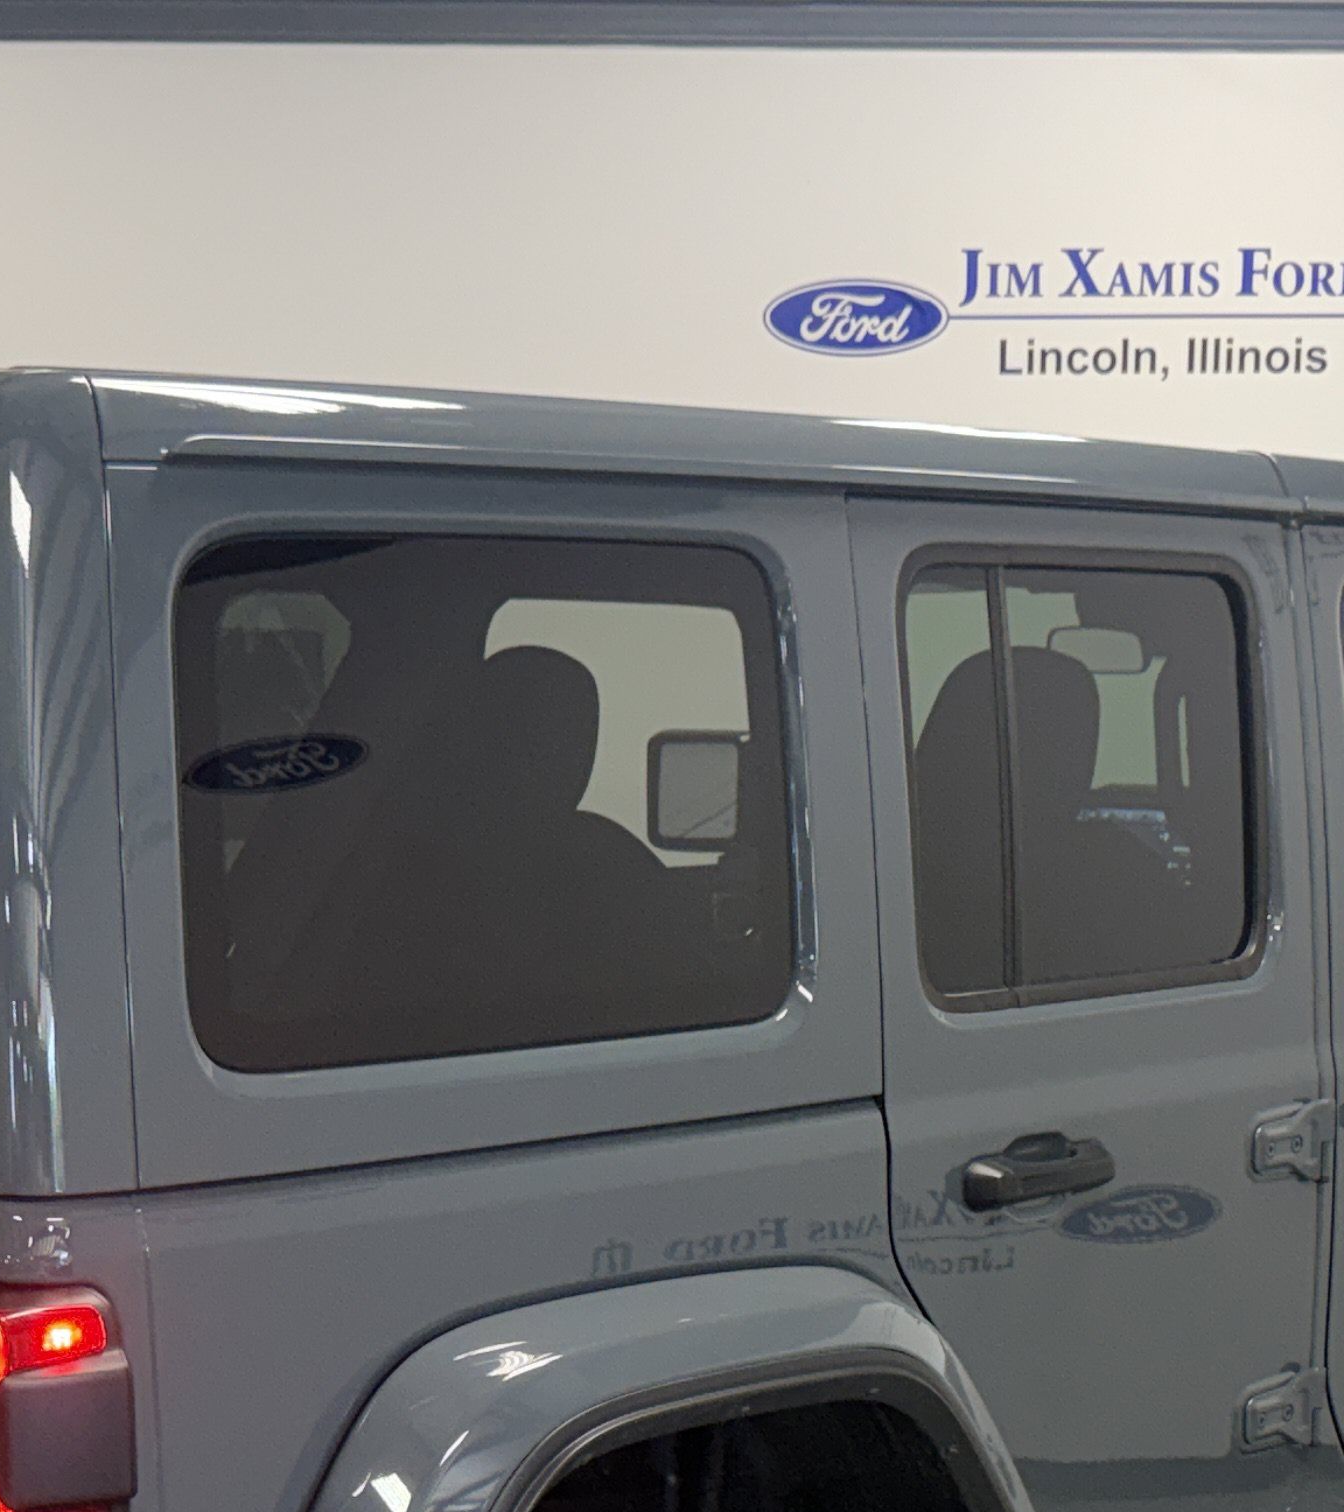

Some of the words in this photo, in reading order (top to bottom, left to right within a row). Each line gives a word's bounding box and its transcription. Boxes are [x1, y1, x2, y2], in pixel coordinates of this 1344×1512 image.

[959, 248, 1044, 308] JIM
[1059, 248, 1221, 298] XAMIS
[798, 293, 912, 344] Ford
[998, 338, 1170, 381] Lincoln,
[1187, 338, 1328, 375] Illinois
